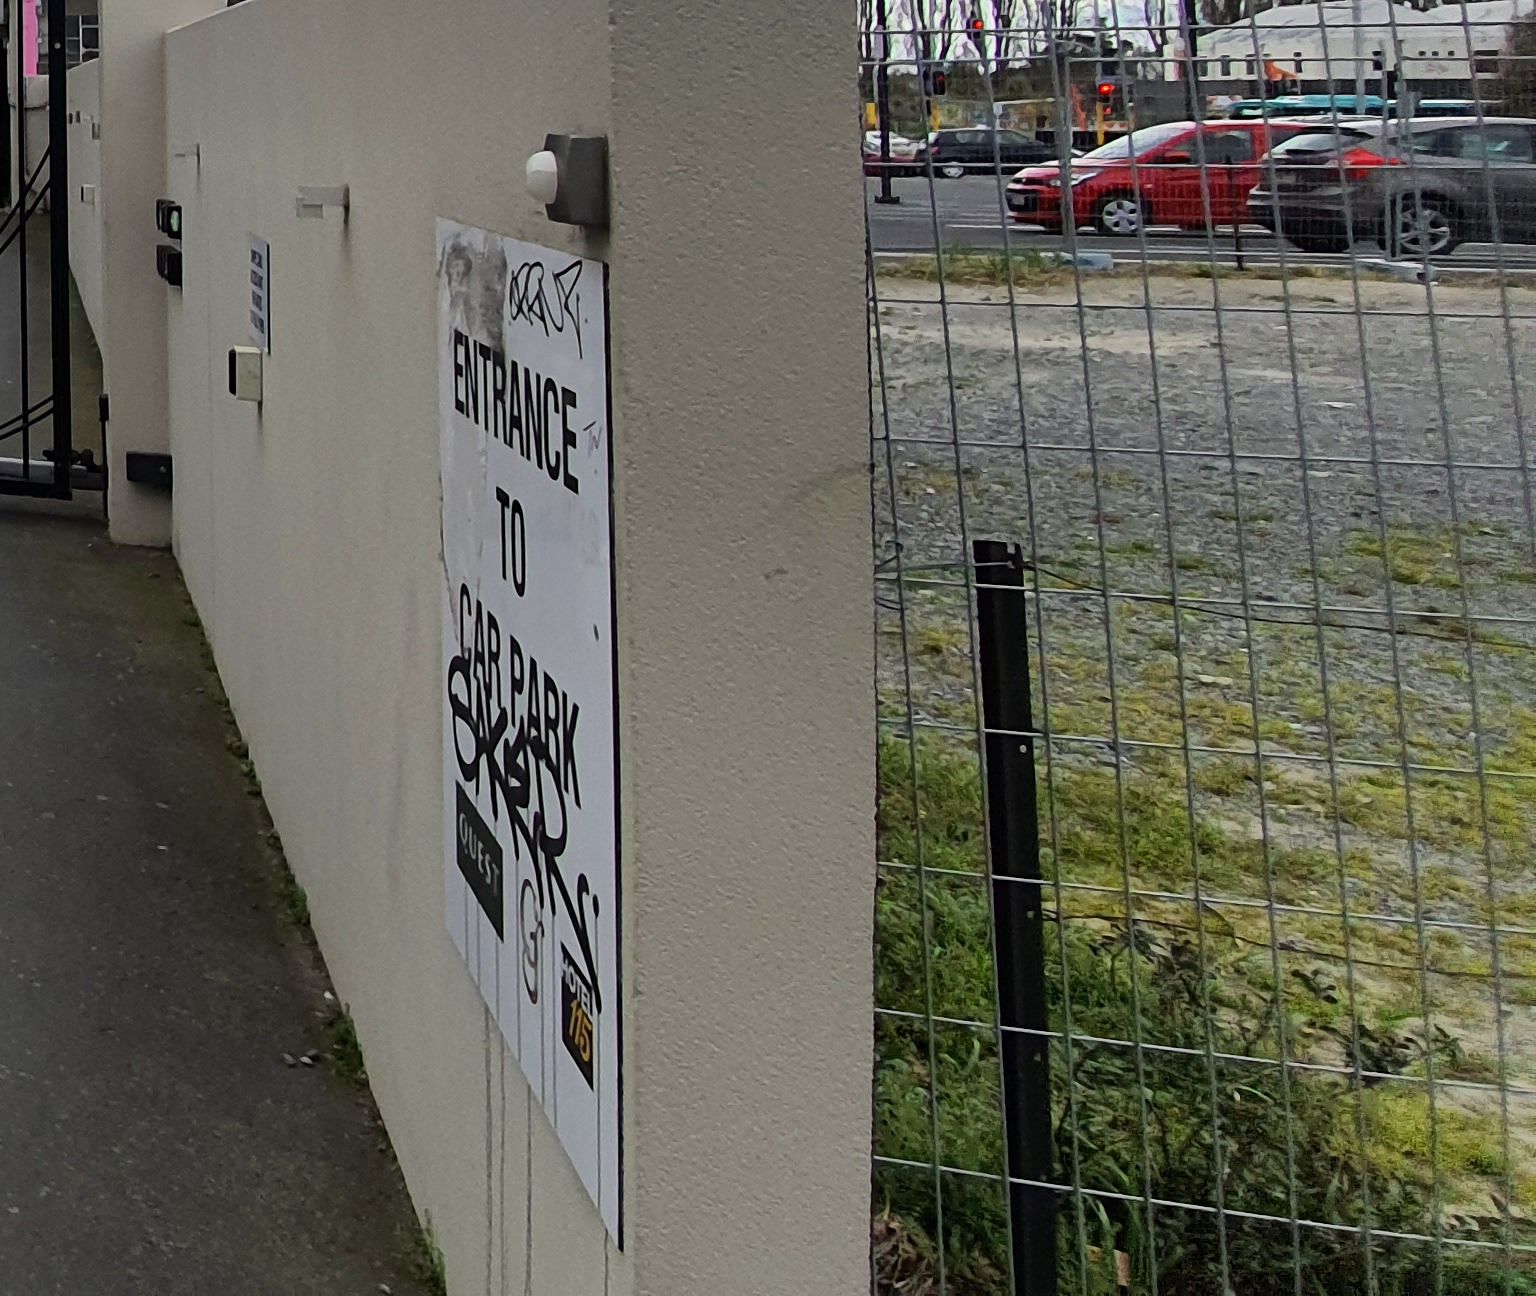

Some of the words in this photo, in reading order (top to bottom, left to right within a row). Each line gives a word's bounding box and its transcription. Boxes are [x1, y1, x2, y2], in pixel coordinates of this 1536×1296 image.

[453, 327, 580, 496] ENTRANCE
[495, 485, 527, 598] TO
[459, 582, 502, 712] CAR
[510, 633, 582, 810] PARK
[458, 812, 501, 897] QUEST
[561, 958, 593, 1022] HOTEL
[568, 999, 593, 1063] 115
